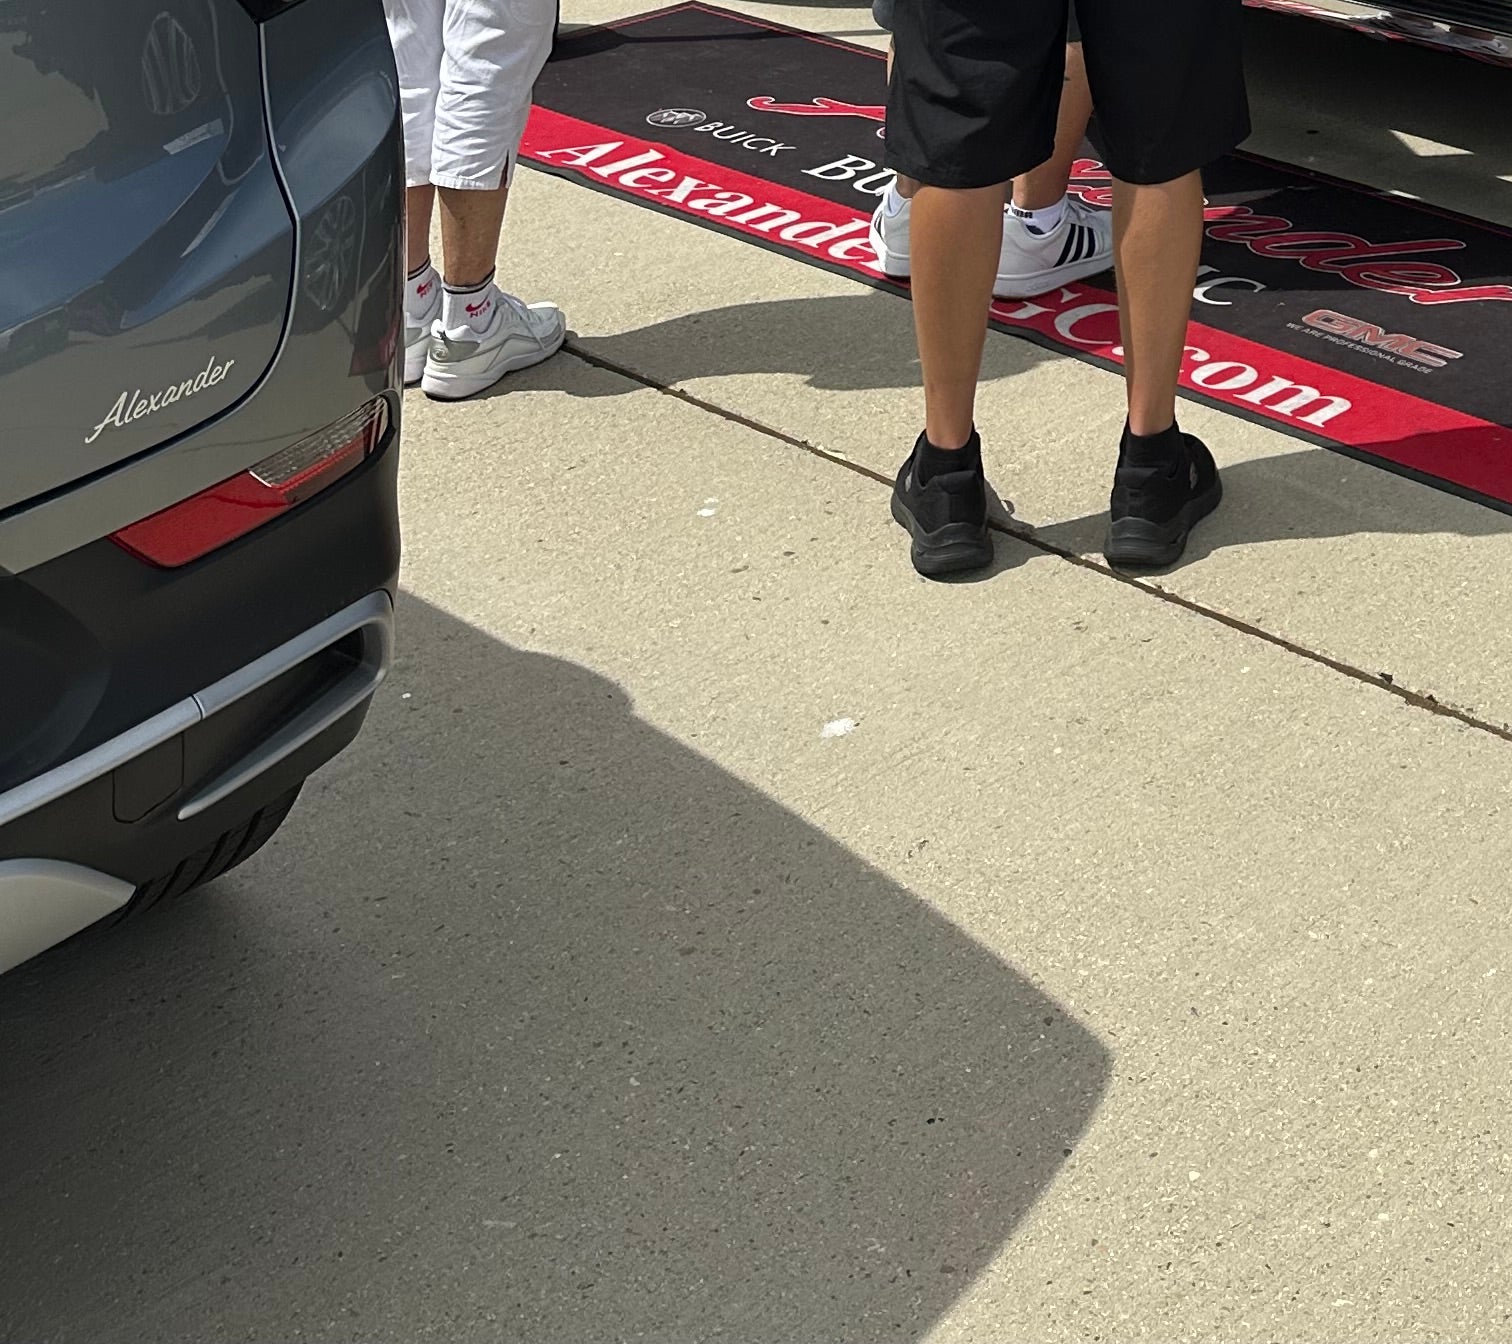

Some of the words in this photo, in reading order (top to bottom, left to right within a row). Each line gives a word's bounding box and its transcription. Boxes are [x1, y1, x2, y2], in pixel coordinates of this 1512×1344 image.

[694, 120, 797, 157] BUICK
[1301, 308, 1464, 368] GMC
[84, 355, 235, 444] Alexander
